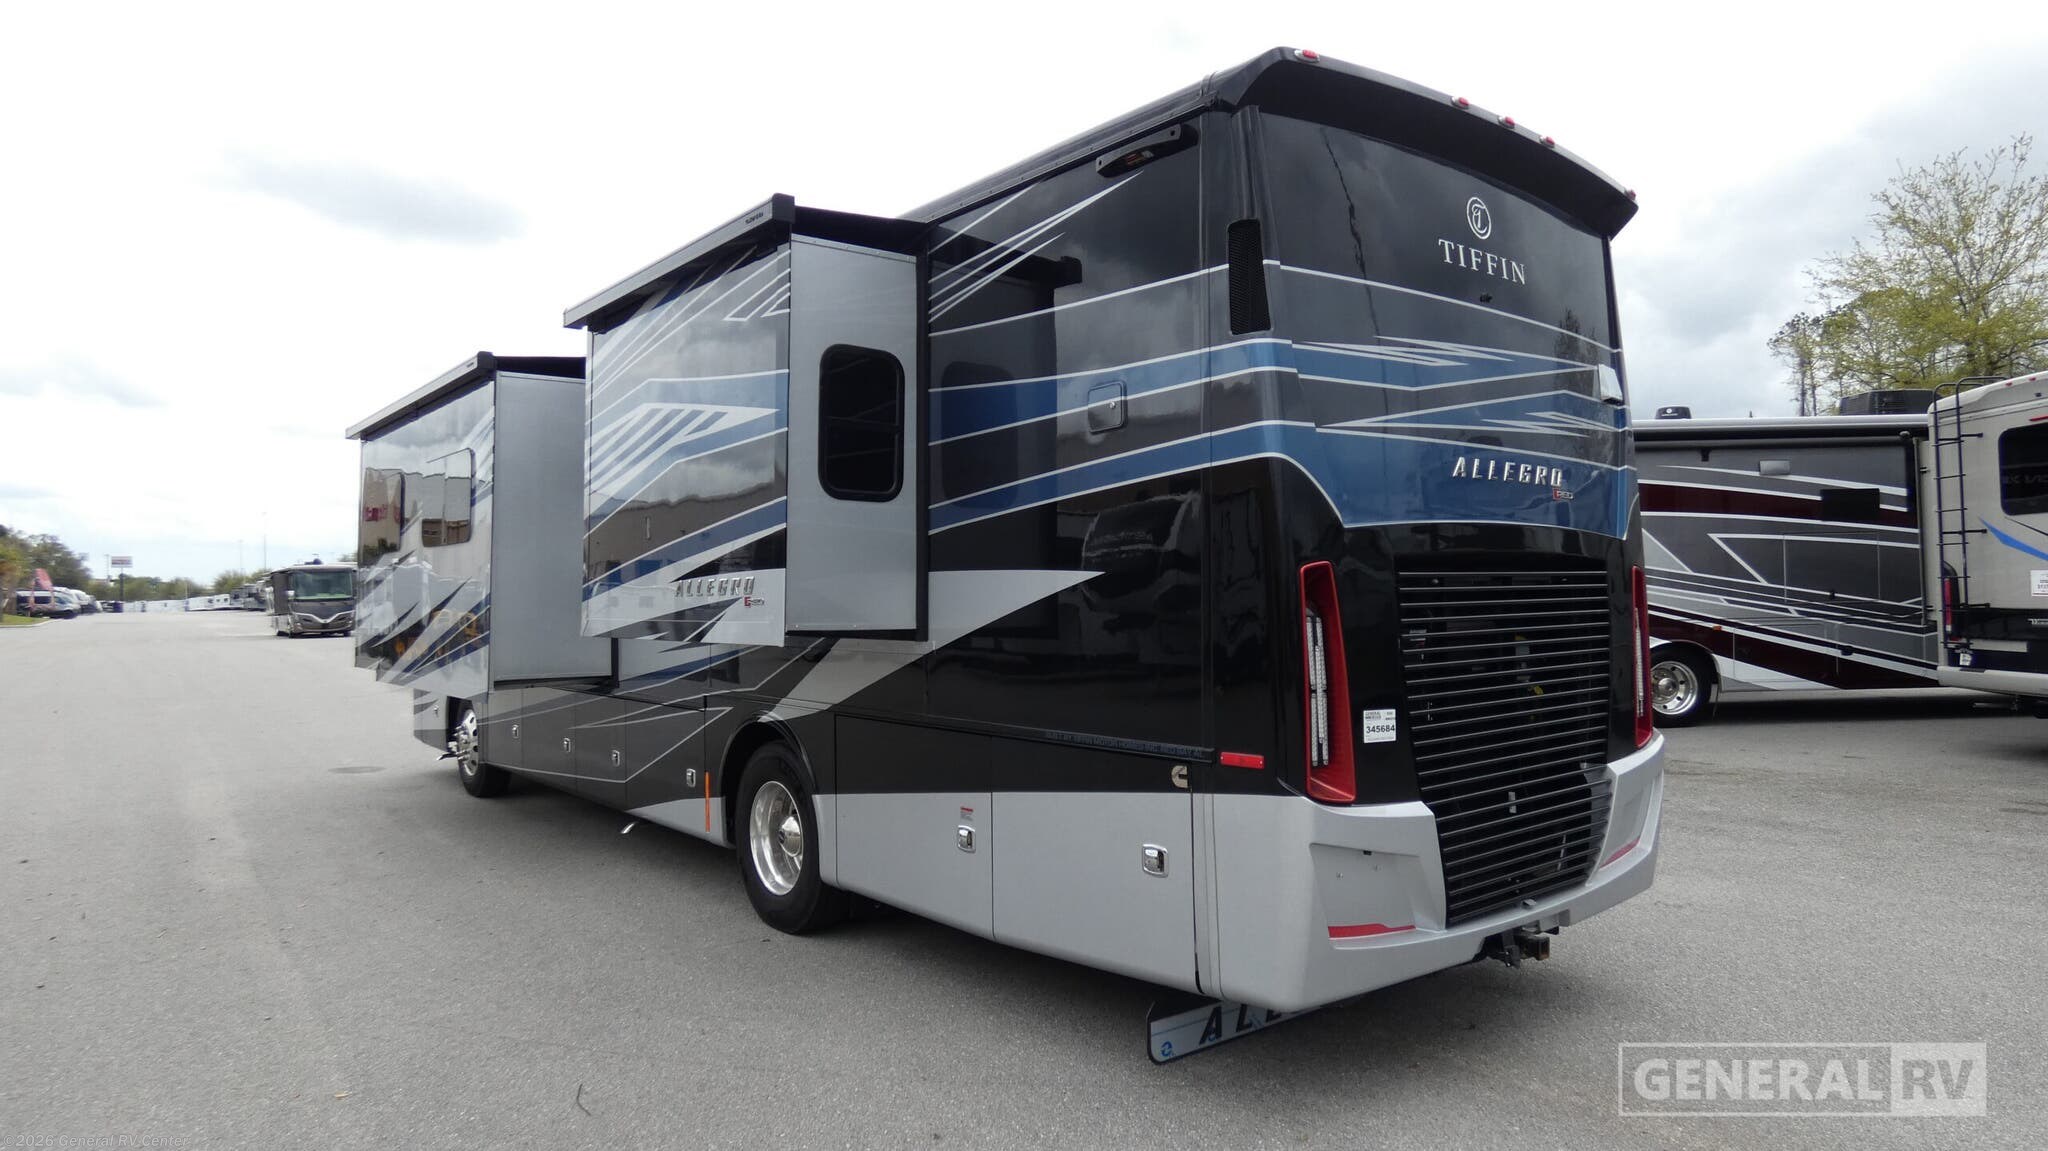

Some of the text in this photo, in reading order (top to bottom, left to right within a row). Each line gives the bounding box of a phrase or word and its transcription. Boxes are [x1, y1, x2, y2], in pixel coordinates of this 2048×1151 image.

[1438, 238, 1526, 285] TIFFIN
[1452, 456, 1563, 487] ALLEGRO
[674, 575, 756, 597] ALLEGRO
[1365, 724, 1395, 734] 345684
